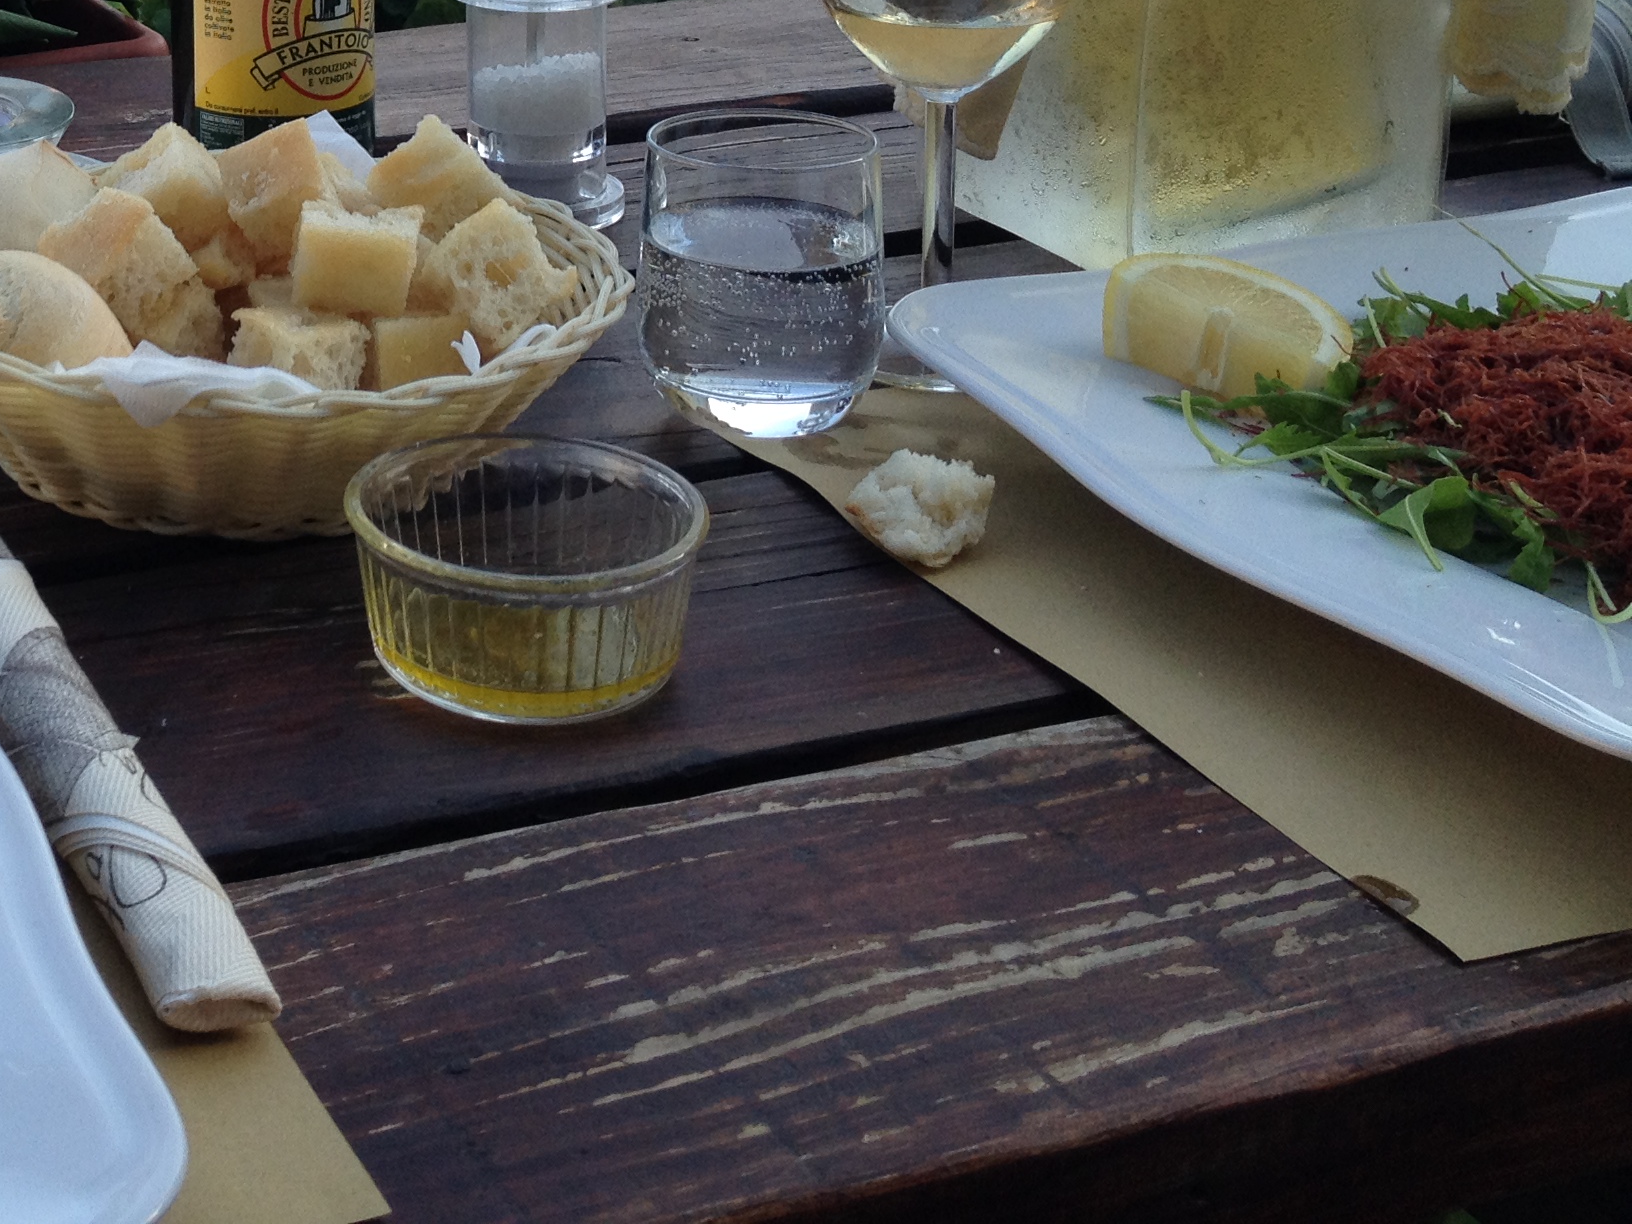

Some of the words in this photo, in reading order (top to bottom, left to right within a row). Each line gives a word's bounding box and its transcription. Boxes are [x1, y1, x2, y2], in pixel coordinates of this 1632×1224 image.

[276, 33, 369, 66] FRANTOIO
[302, 59, 358, 77] PRODUZIONE
[308, 78, 315, 87] E
[319, 72, 354, 86] VENDITA
